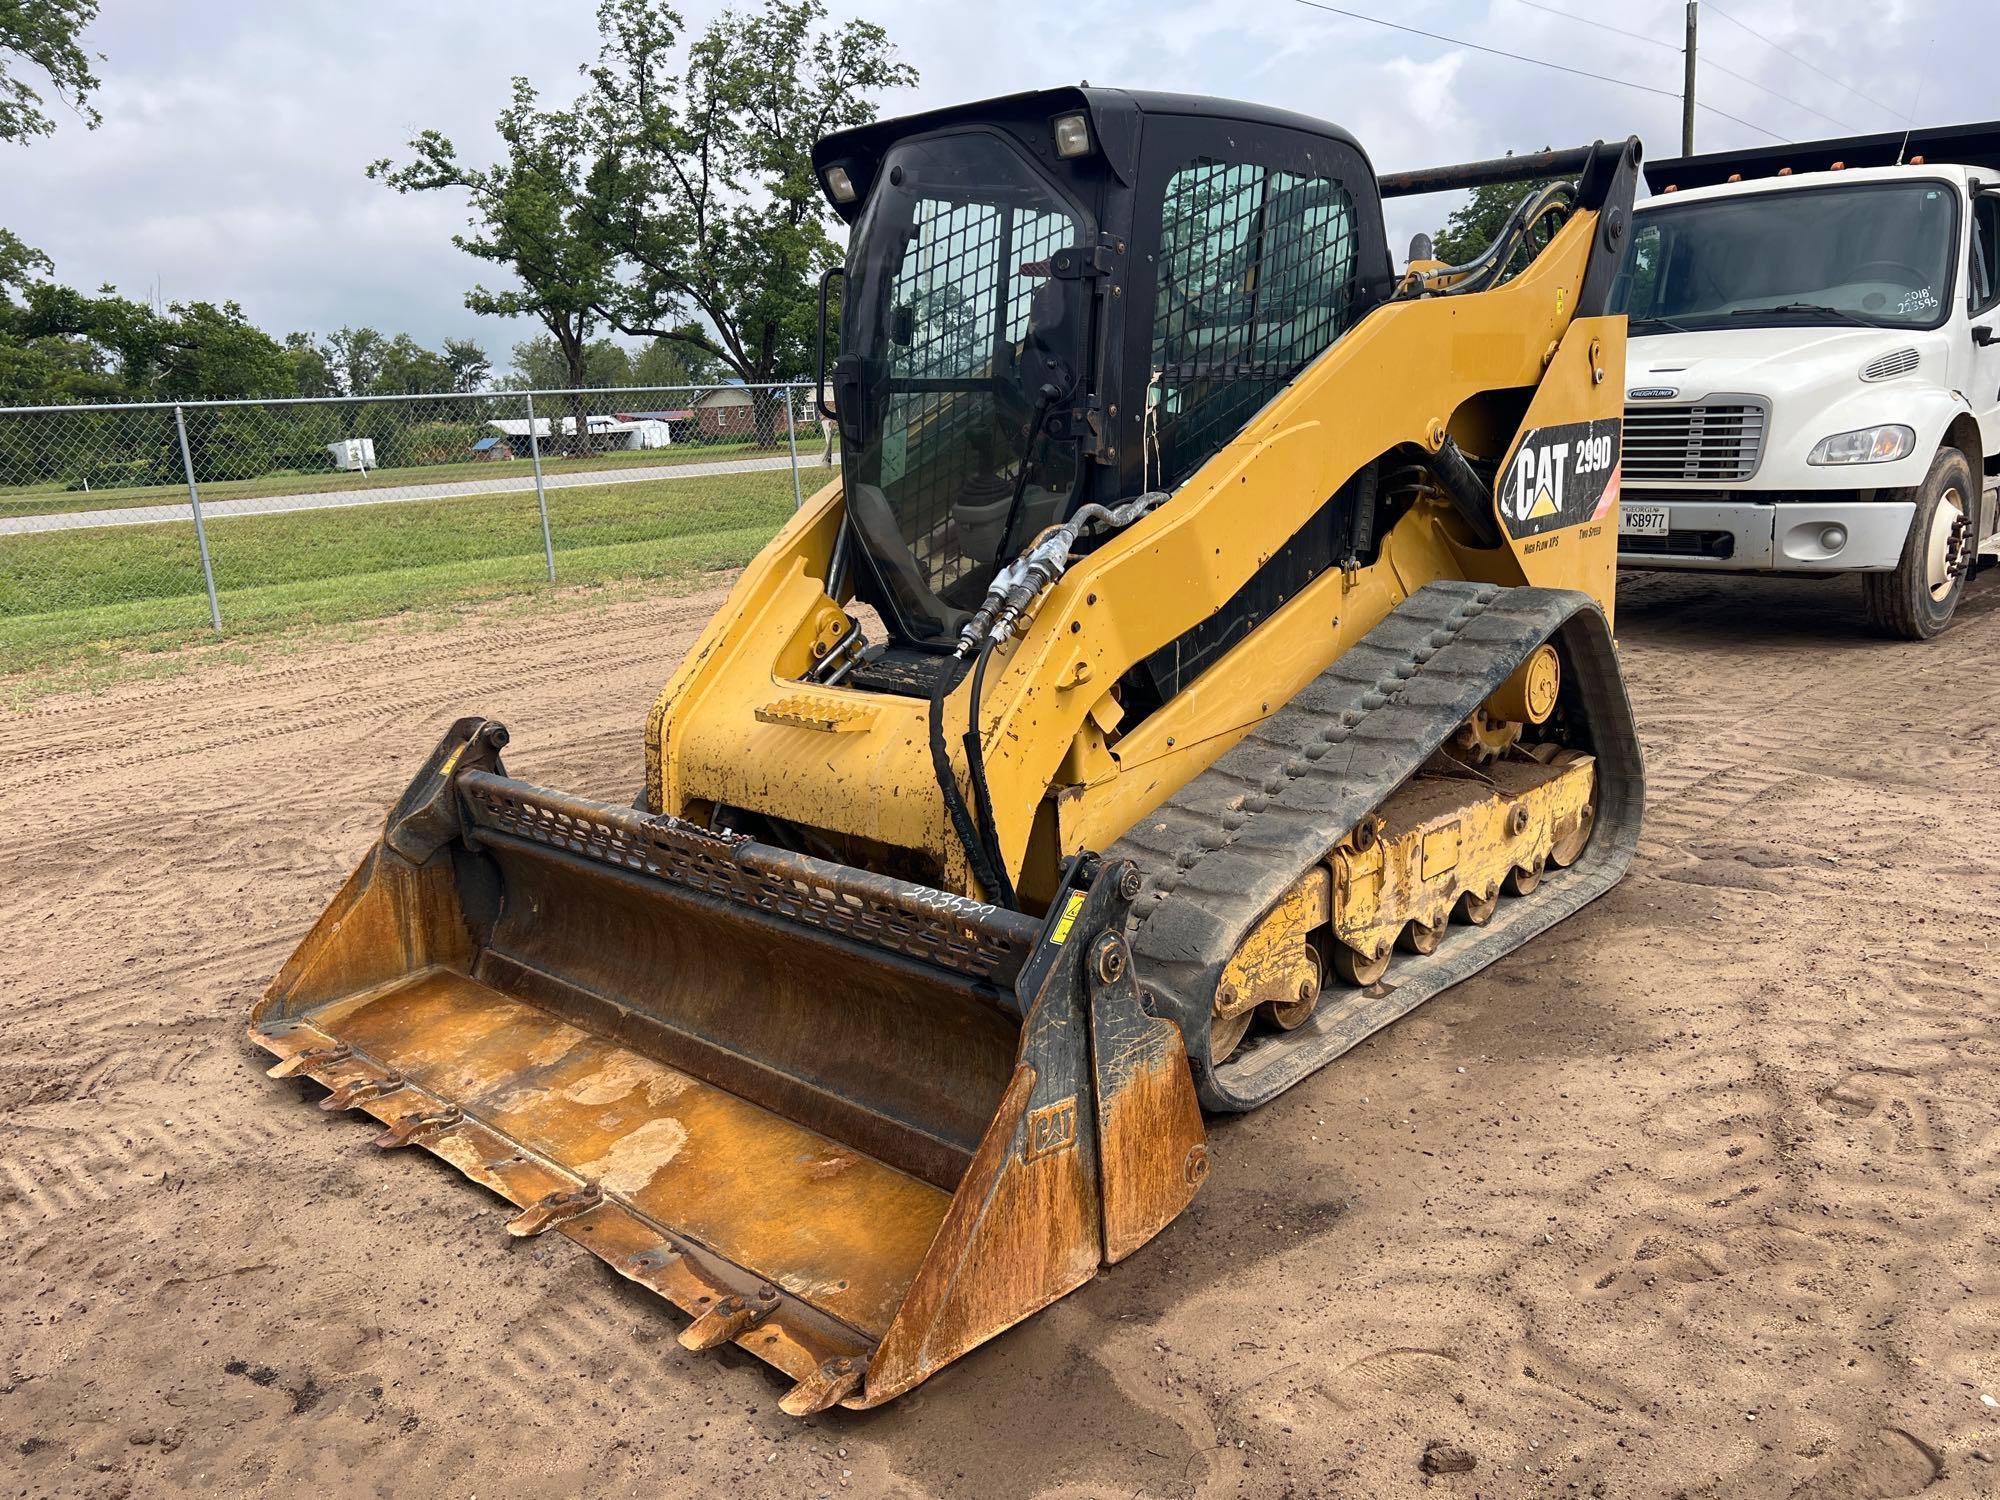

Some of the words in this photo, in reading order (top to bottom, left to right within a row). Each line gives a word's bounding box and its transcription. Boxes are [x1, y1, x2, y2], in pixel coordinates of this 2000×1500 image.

[1897, 297, 1938, 314] 223595
[1631, 389, 1673, 397] FREIGHTLINER
[1516, 443, 1569, 521] CAT
[1575, 436, 1612, 475] 299D
[1625, 513, 1665, 528] WSB977
[1549, 536, 1559, 548] XPS
[1035, 1107, 1073, 1153] CAT
